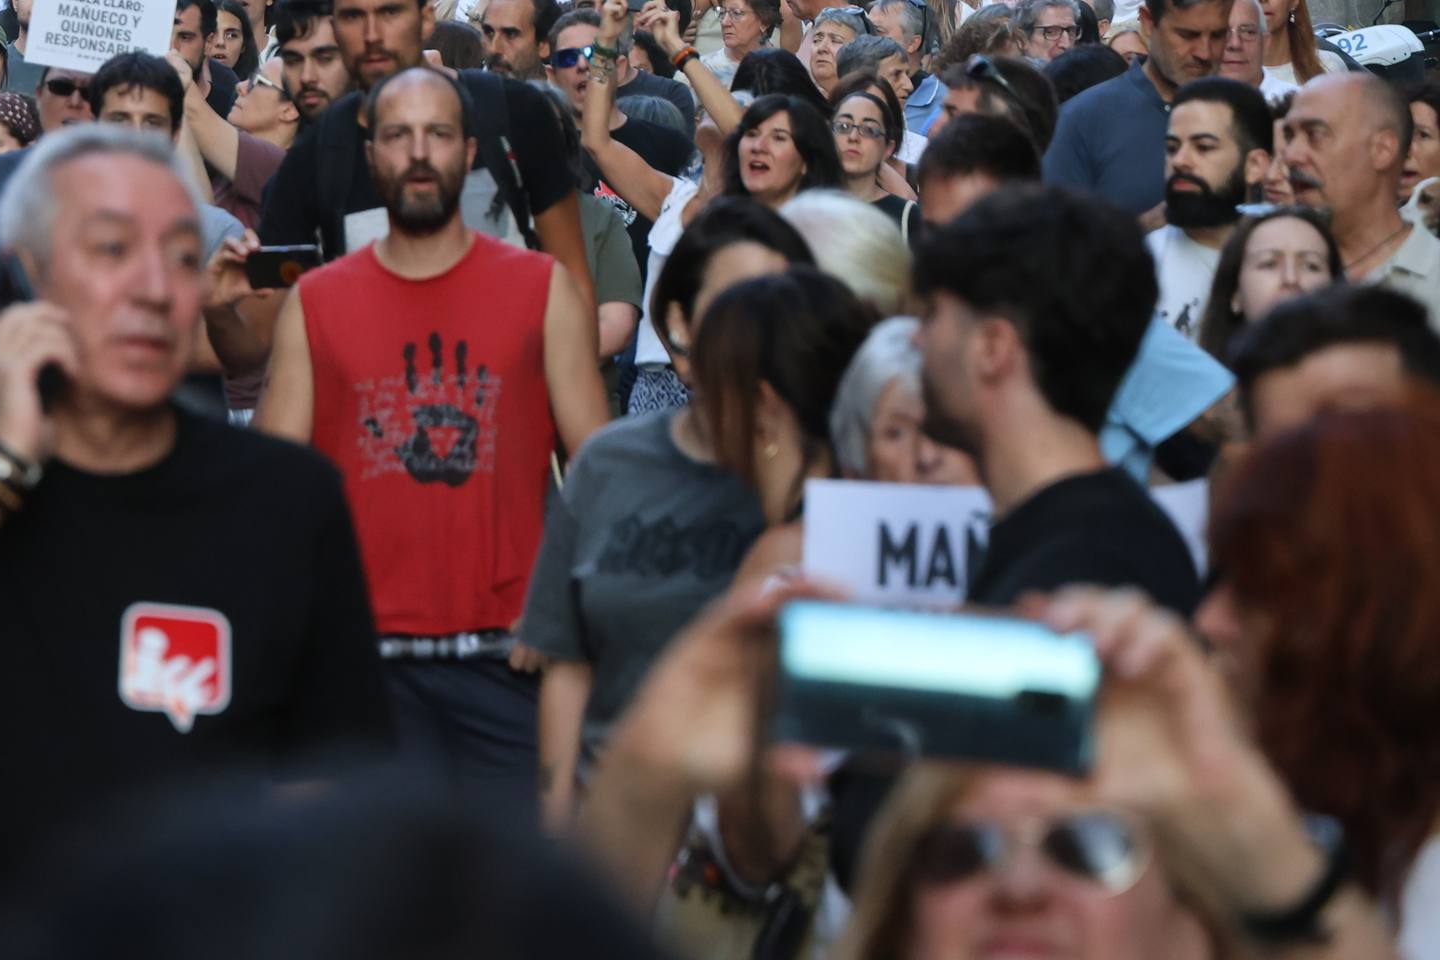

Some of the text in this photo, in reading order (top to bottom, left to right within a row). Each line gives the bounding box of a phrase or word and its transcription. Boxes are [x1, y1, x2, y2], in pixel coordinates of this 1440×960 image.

[58, 4, 142, 28] MAÑUECO Y
[61, 19, 132, 42] QUIÑONES
